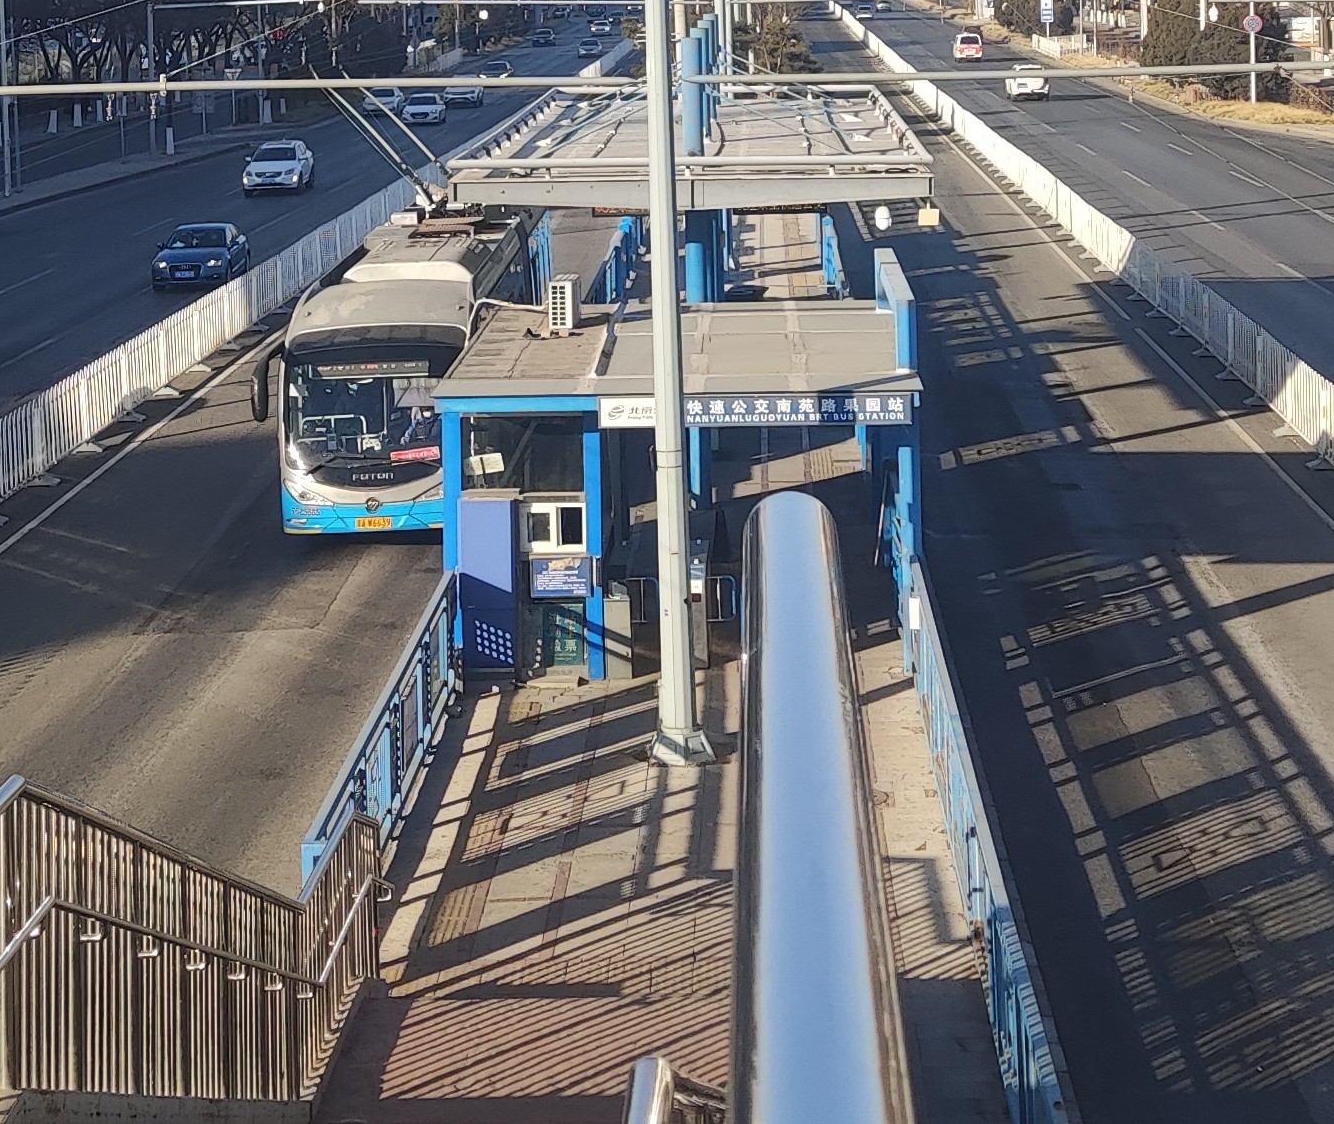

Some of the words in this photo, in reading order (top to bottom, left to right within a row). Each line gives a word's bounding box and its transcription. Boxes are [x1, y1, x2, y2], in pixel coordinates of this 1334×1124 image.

[686, 397, 904, 415] 快速公交南苑路果园站
[686, 413, 805, 423] NANYUANLUGUOYUAN
[809, 413, 829, 422] BRT
[833, 412, 854, 421] BUS
[858, 411, 905, 421] STATION
